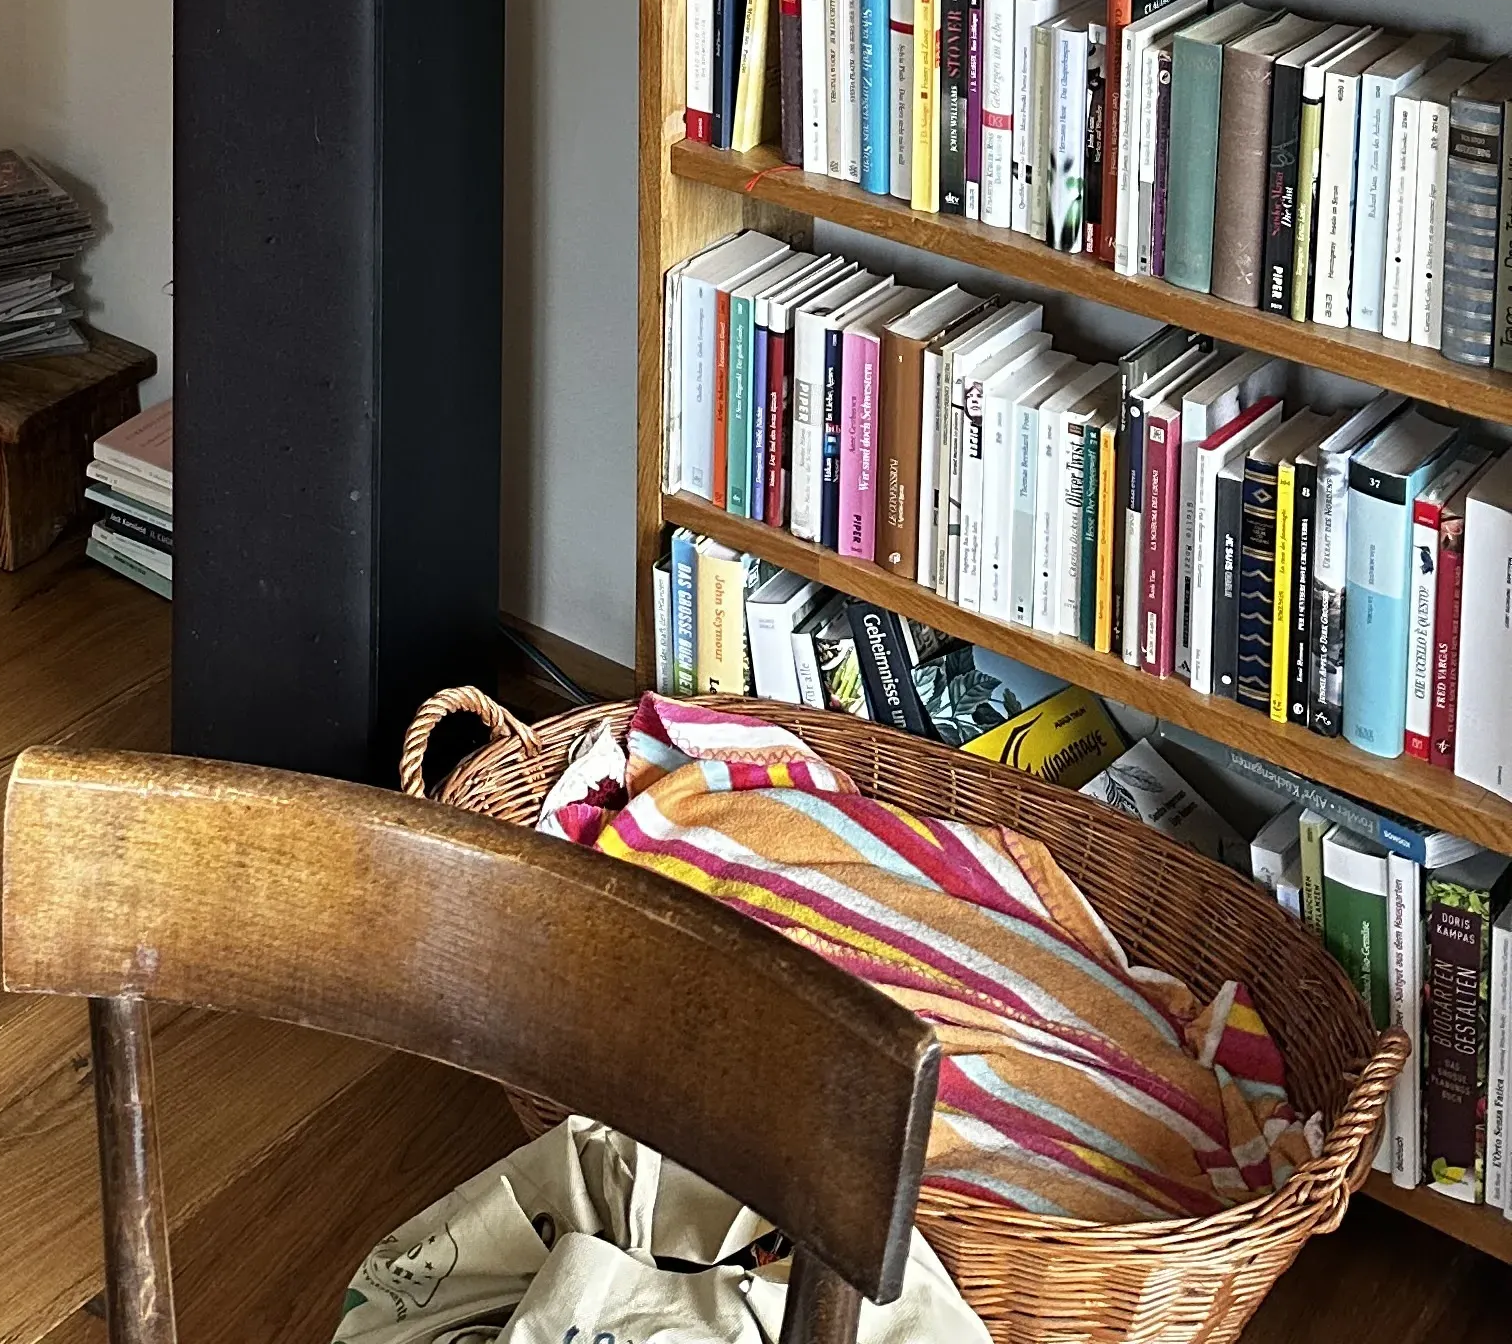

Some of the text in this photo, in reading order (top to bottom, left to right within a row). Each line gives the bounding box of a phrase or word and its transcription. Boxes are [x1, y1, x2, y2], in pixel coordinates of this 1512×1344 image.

[862, 8, 872, 38] Sylvia
[947, 10, 962, 79] STONER
[863, 43, 872, 70] Plath
[950, 85, 958, 152] JOHN WILLIAMS
[862, 144, 873, 172] Stein
[1272, 266, 1284, 301] PIPER
[796, 382, 809, 423] PIPER
[859, 363, 873, 492] Wir sind doch Schwestern
[1065, 442, 1085, 508] Oliver Twist
[1369, 478, 1381, 489] 37
[678, 562, 692, 588] DAS
[678, 590, 692, 638] GROSSE
[713, 575, 725, 663] John Seymour
[1417, 585, 1431, 627] QUESTO?
[678, 641, 693, 671] BUCH
[863, 613, 902, 706] Geheimnisse
[1416, 637, 1428, 678] UCCELLO
[1436, 643, 1448, 709] FRED VARGAS
[1414, 680, 1425, 699] CHE
[1231, 753, 1300, 797] Küchengarten
[1394, 879, 1406, 1002] Saatgut aus dem Hausgarten
[1435, 924, 1475, 945] KAMPAS
[1441, 912, 1471, 930] DORIS
[1432, 959, 1454, 1048] BIOGARTEN
[1455, 967, 1477, 1055] GESTALTEN
[1492, 1078, 1505, 1168] L'Orto Senza Fatica
